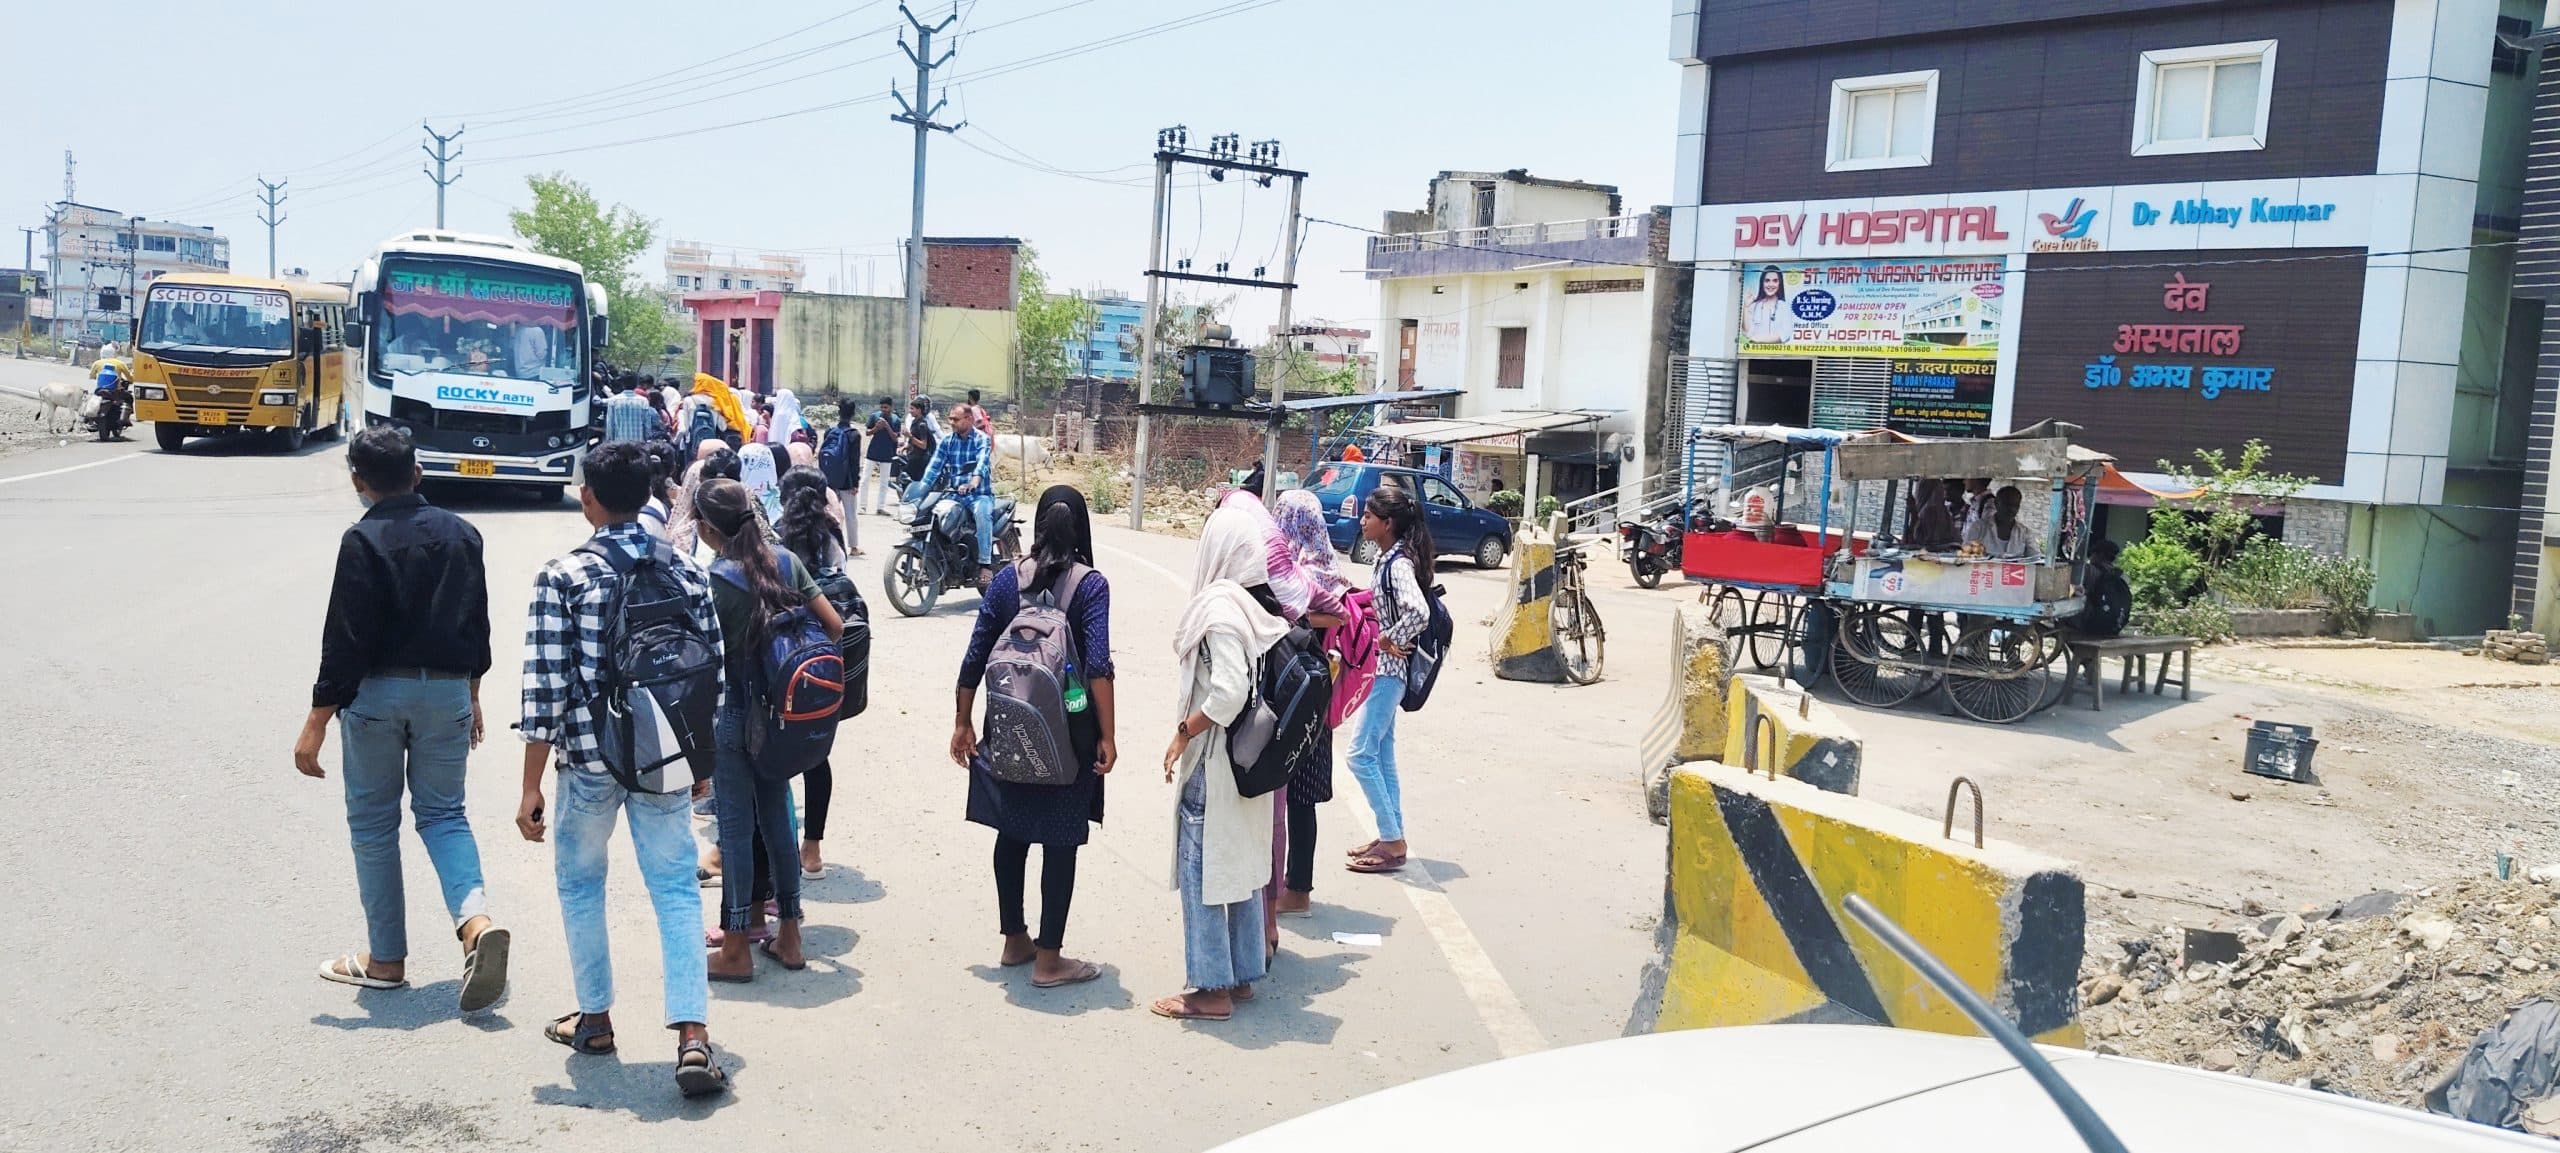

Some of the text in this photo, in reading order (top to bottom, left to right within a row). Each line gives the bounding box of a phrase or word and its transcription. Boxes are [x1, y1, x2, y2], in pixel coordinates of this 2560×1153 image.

[2133, 198, 2336, 228] Dr Abhay Kumar
[1735, 205, 2008, 247] DEV HOSPITAL
[2032, 238, 2098, 252] Care for life
[391, 271, 434, 295] जय
[1827, 266, 1862, 284] MARY
[1865, 264, 1925, 283] NURSING
[1929, 263, 2001, 282] INSTITUTE
[157, 290, 284, 307] SCHOOL BUS
[2163, 272, 2210, 312] देव
[1793, 330, 1901, 341] DEV HOSPITAL
[2113, 324, 2244, 355] अस्पताल
[192, 368, 228, 377] SCHOOL
[1916, 363, 1947, 374] उदय
[1949, 364, 1995, 375] प्रकाश
[2129, 365, 2192, 389] अभय
[2201, 366, 2274, 399] कुमार
[437, 386, 500, 400] ROCKY
[2010, 568, 2025, 581] V
[1012, 723, 1050, 777] fastrack
